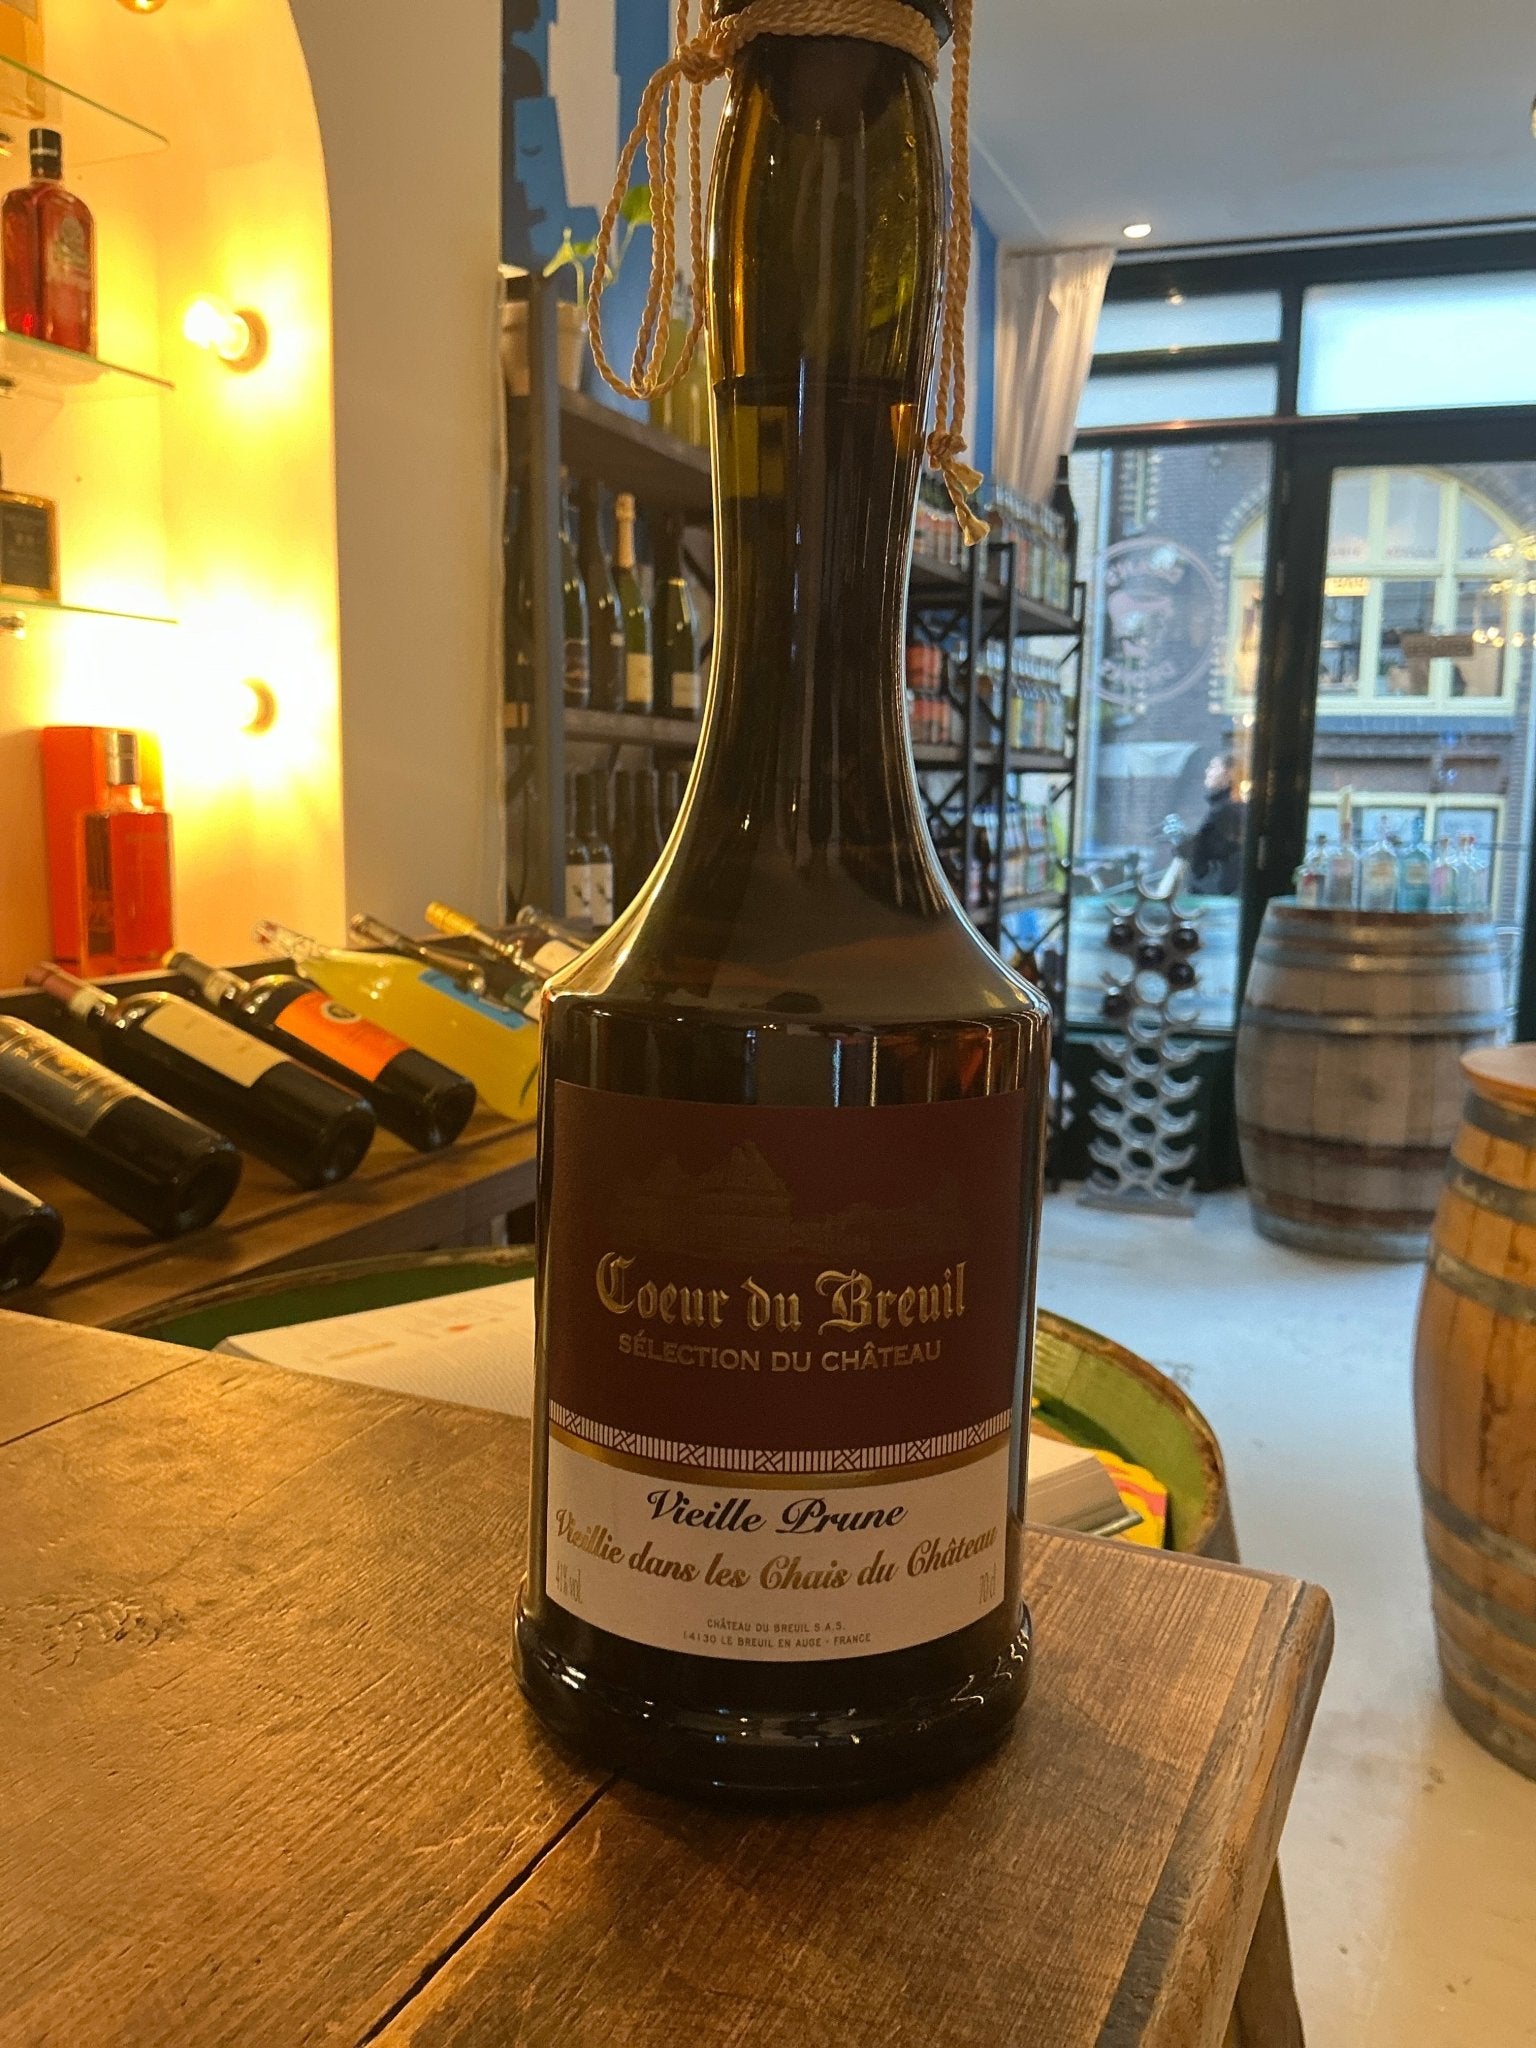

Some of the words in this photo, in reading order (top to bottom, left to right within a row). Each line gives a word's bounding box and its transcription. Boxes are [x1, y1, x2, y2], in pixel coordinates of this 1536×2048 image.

[596, 1252, 730, 1328] Coeur
[740, 1276, 801, 1332] du
[815, 1261, 968, 1336] Breuil
[618, 1329, 760, 1371] SÉLECTION
[771, 1351, 811, 1372] DU
[821, 1340, 941, 1372] CHÂTEAU
[647, 1489, 767, 1532] Vieille
[775, 1497, 908, 1534] Prune
[555, 1508, 625, 1564] Vieillie
[628, 1541, 700, 1582] dans
[704, 1552, 750, 1588] les
[759, 1554, 851, 1590] Chais
[857, 1549, 899, 1586] du
[907, 1526, 998, 1577] Château
[683, 1630, 717, 1645] 14130
[721, 1635, 733, 1646] LE
[737, 1636, 774, 1648] BREUIL
[779, 1639, 791, 1648] EN
[796, 1637, 821, 1647] AUGE
[834, 1632, 871, 1646] FRANCE
[707, 1617, 751, 1632] CHÂTEAU
[756, 1622, 769, 1633] DU
[774, 1623, 810, 1633] BREUIL
